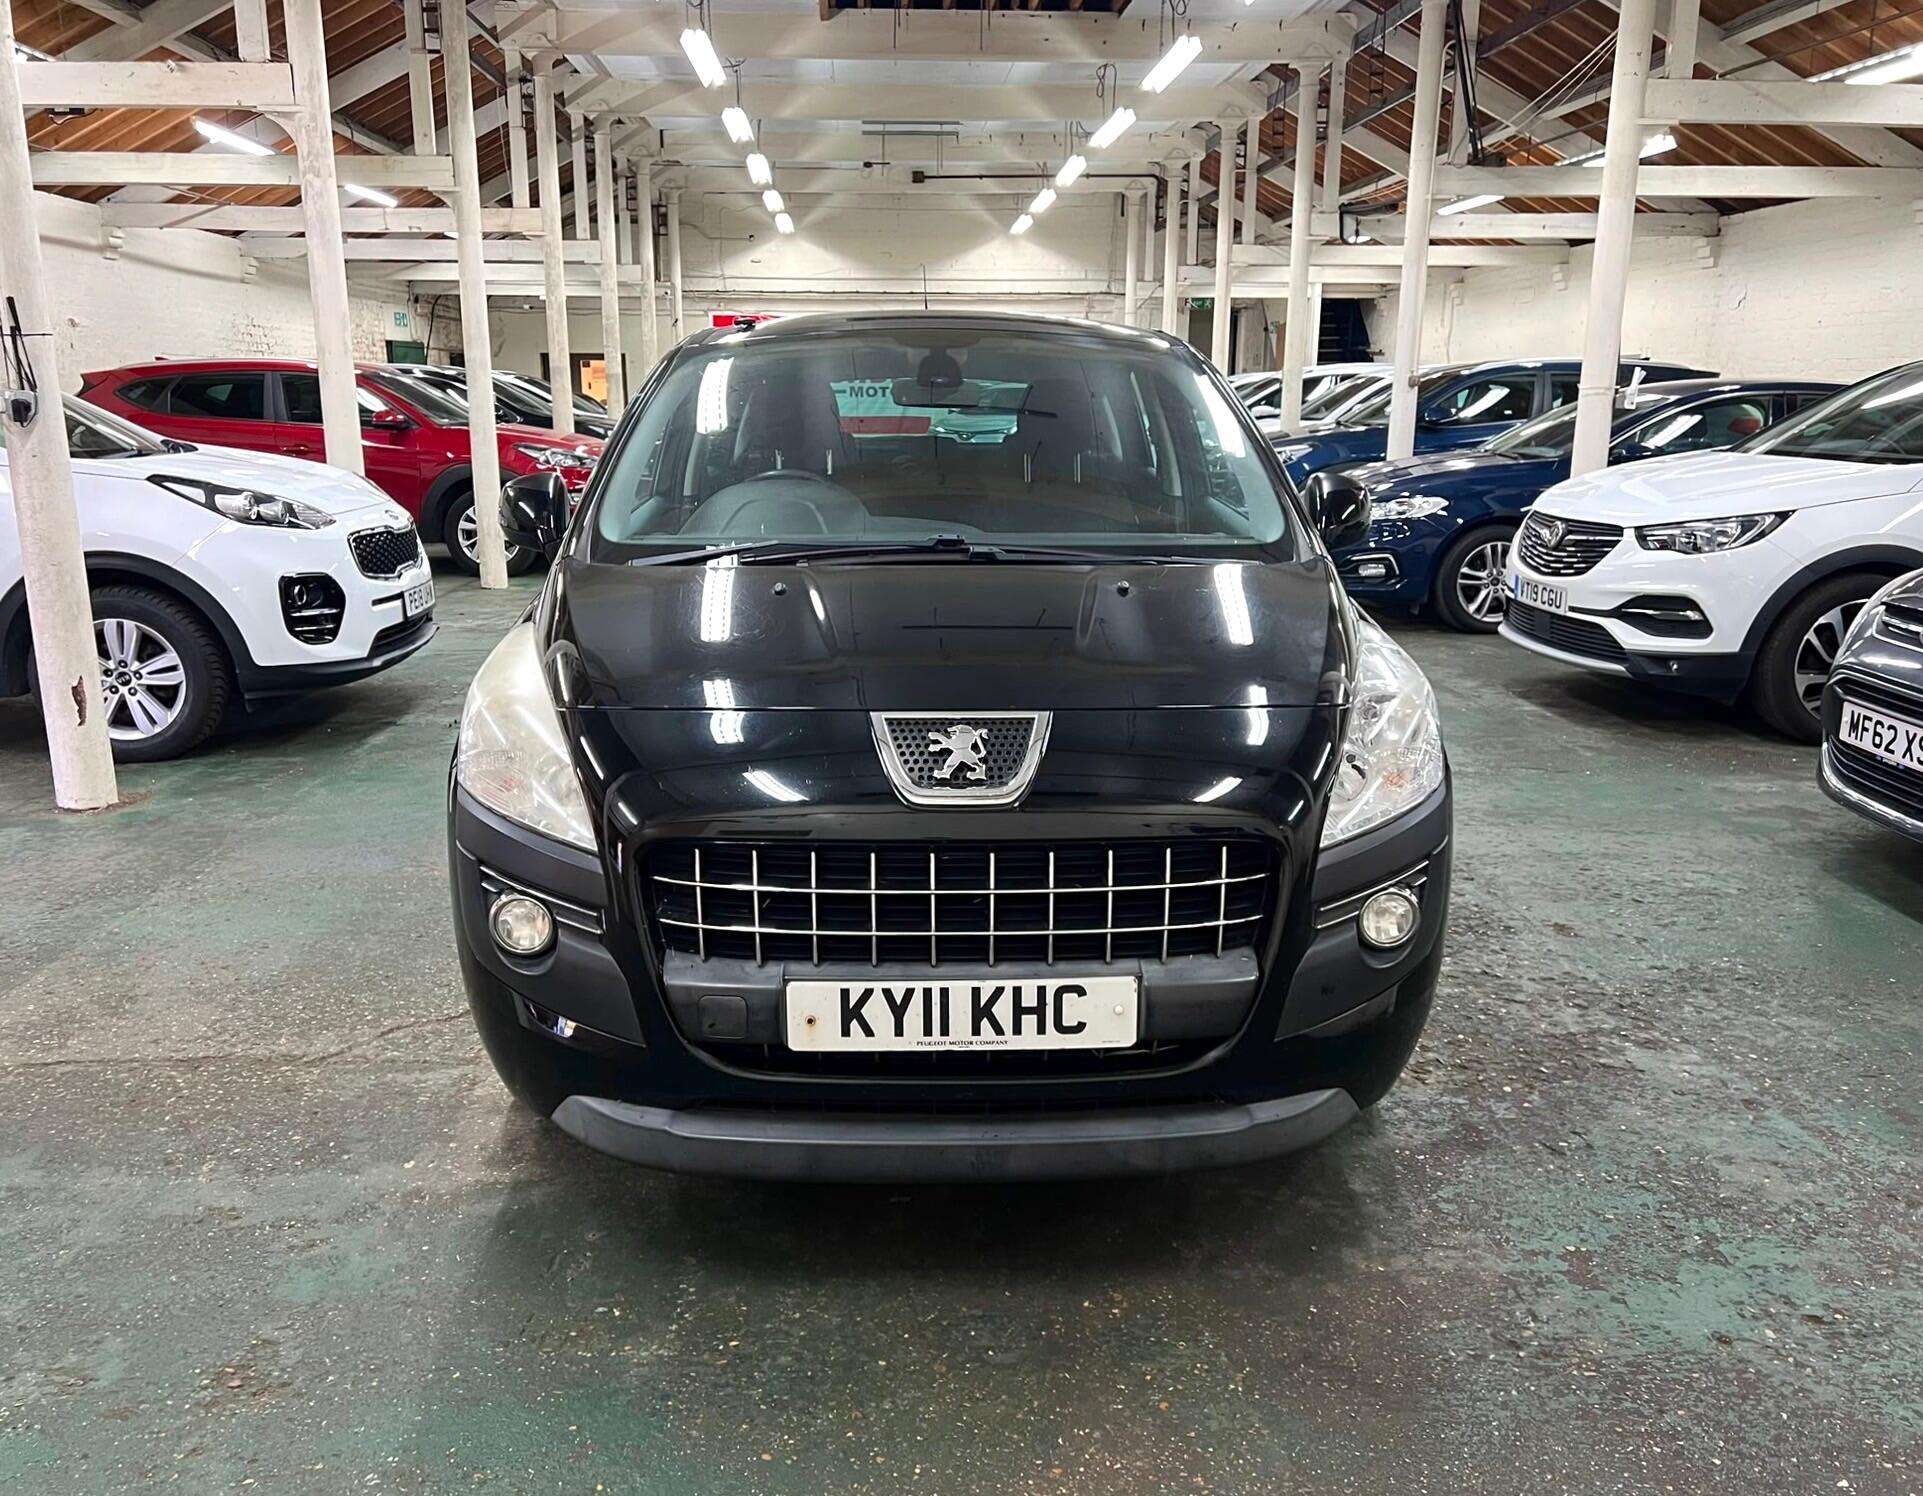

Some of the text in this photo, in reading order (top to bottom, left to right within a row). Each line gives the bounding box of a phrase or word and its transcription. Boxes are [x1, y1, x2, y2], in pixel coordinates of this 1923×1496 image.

[849, 386, 889, 398] MOT
[1520, 578, 1563, 609] VT19 CGU
[1848, 709, 1898, 756] MF62
[840, 985, 1088, 1038] KY11 KHC
